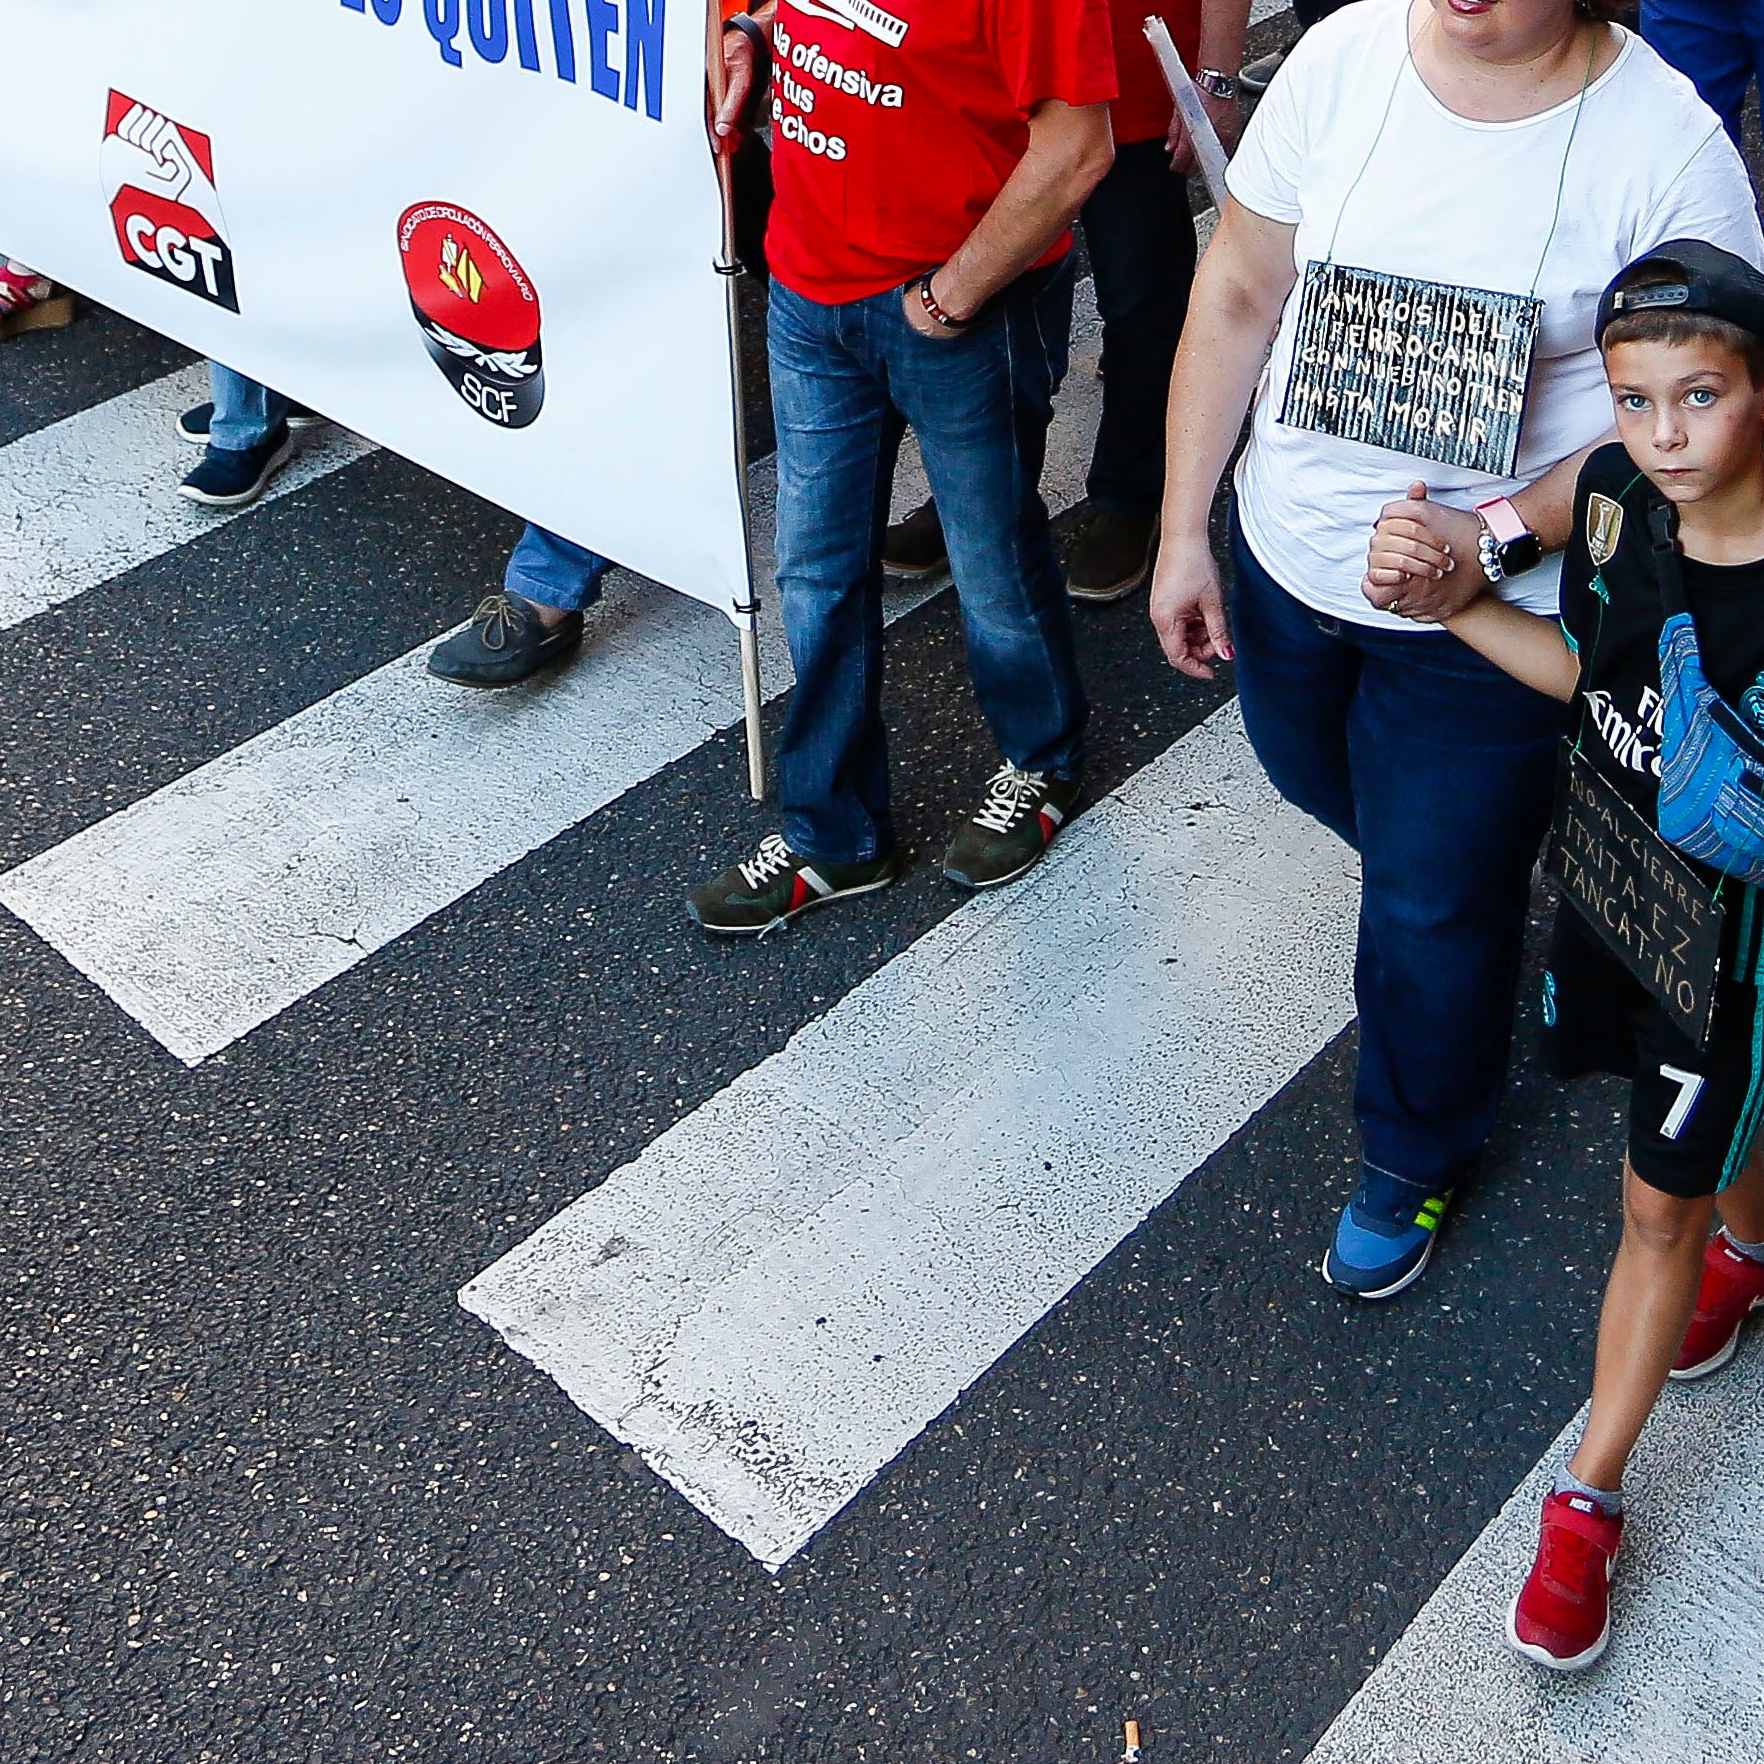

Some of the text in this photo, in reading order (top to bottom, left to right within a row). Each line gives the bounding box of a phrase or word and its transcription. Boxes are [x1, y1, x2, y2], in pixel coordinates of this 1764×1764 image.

[782, 69, 816, 115] tus
[791, 42, 905, 109] ofensiva
[124, 211, 225, 296] CGT
[1331, 319, 1526, 384] FERROCARRIL
[1449, 308, 1513, 341] DEL
[460, 371, 518, 424] SCF
[1301, 343, 1524, 414] CON NUESTRO TREN
[1293, 383, 1488, 446] HASTA MORIR
[1657, 1062, 1707, 1141] 7
[1568, 1496, 1595, 1514] NIKE
